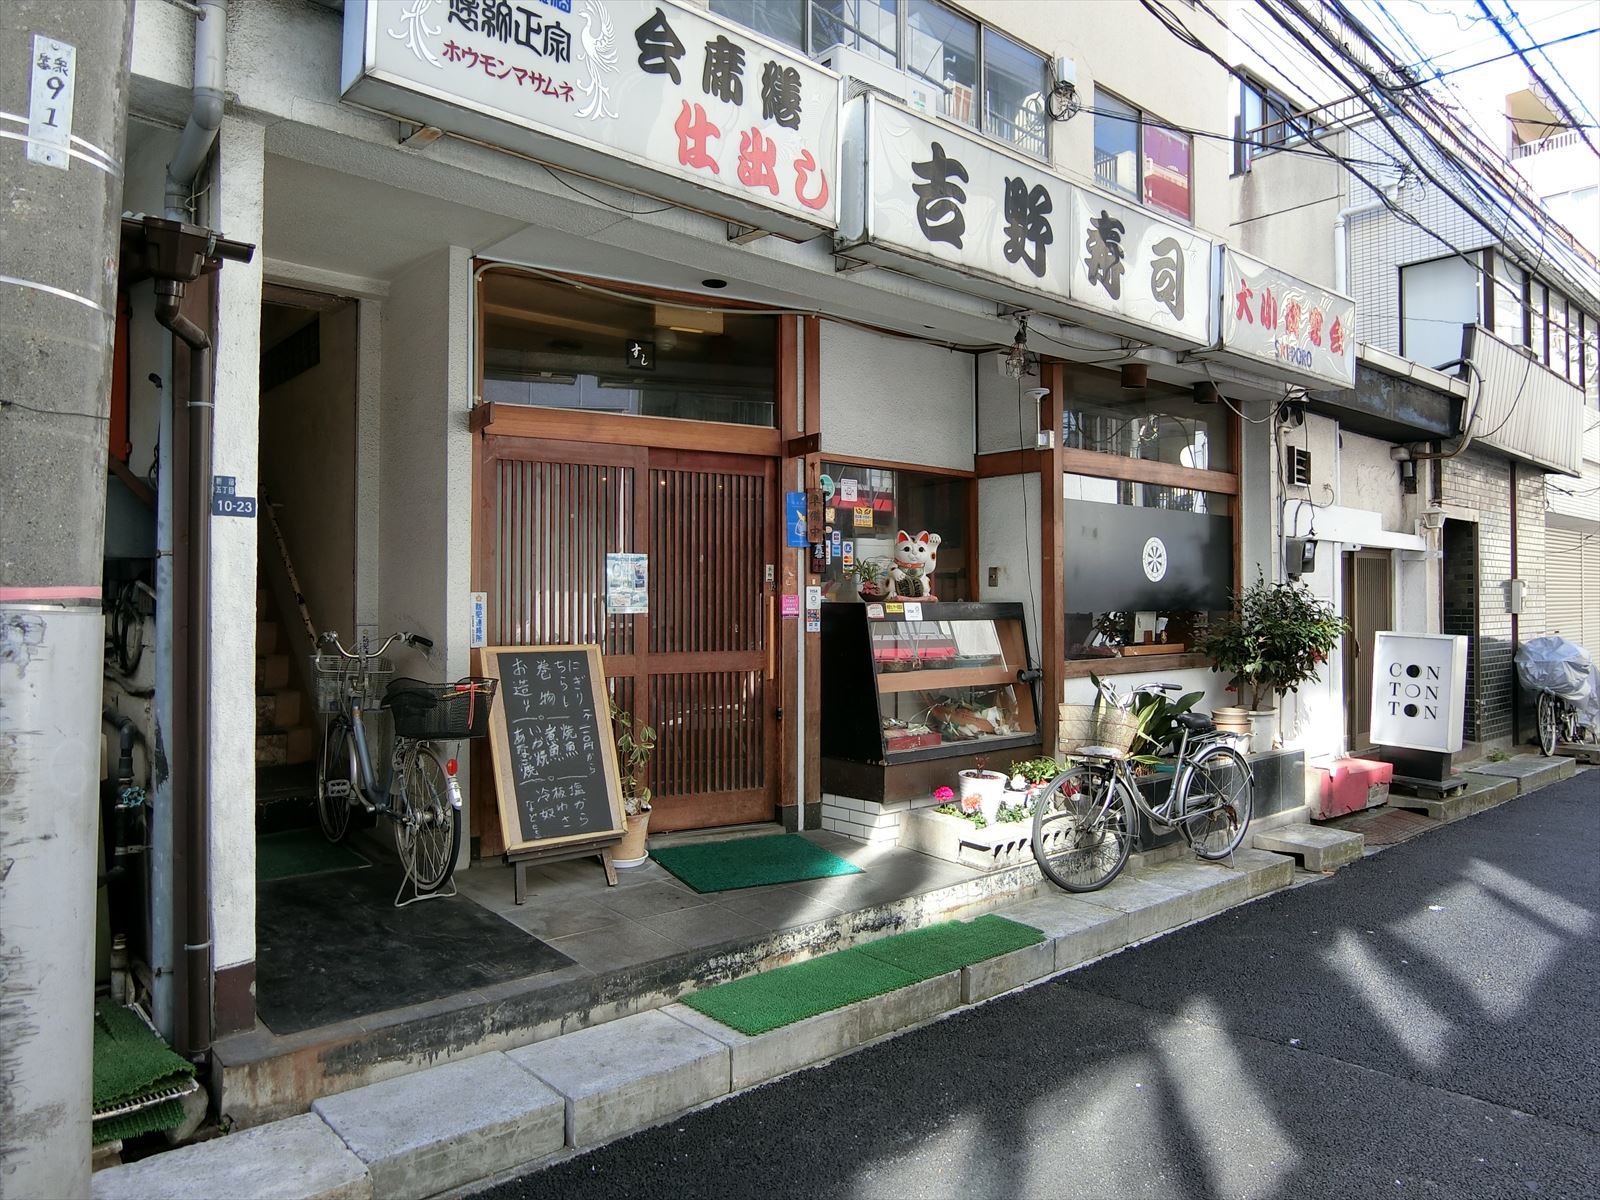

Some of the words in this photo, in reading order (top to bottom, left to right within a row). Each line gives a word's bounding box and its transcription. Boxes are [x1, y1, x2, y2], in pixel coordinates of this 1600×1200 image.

[442, 40, 575, 103] ホウモンマサムネ
[674, 99, 829, 210] 仕出し
[911, 141, 1186, 321] 吉野寿司
[630, 343, 649, 366] すし
[217, 500, 253, 513] 10-23
[512, 657, 532, 712] お造り
[536, 659, 556, 706] 巻物
[554, 660, 569, 708] ちらし
[568, 659, 586, 706] にぎり
[1389, 662, 1440, 680] CON
[1389, 682, 1439, 700] TON
[1388, 701, 1438, 720] TON
[544, 723, 564, 761] 煮魚
[560, 723, 579, 757] 焼魚
[536, 787, 556, 821] 冷奴
[569, 782, 589, 826] 塩から
